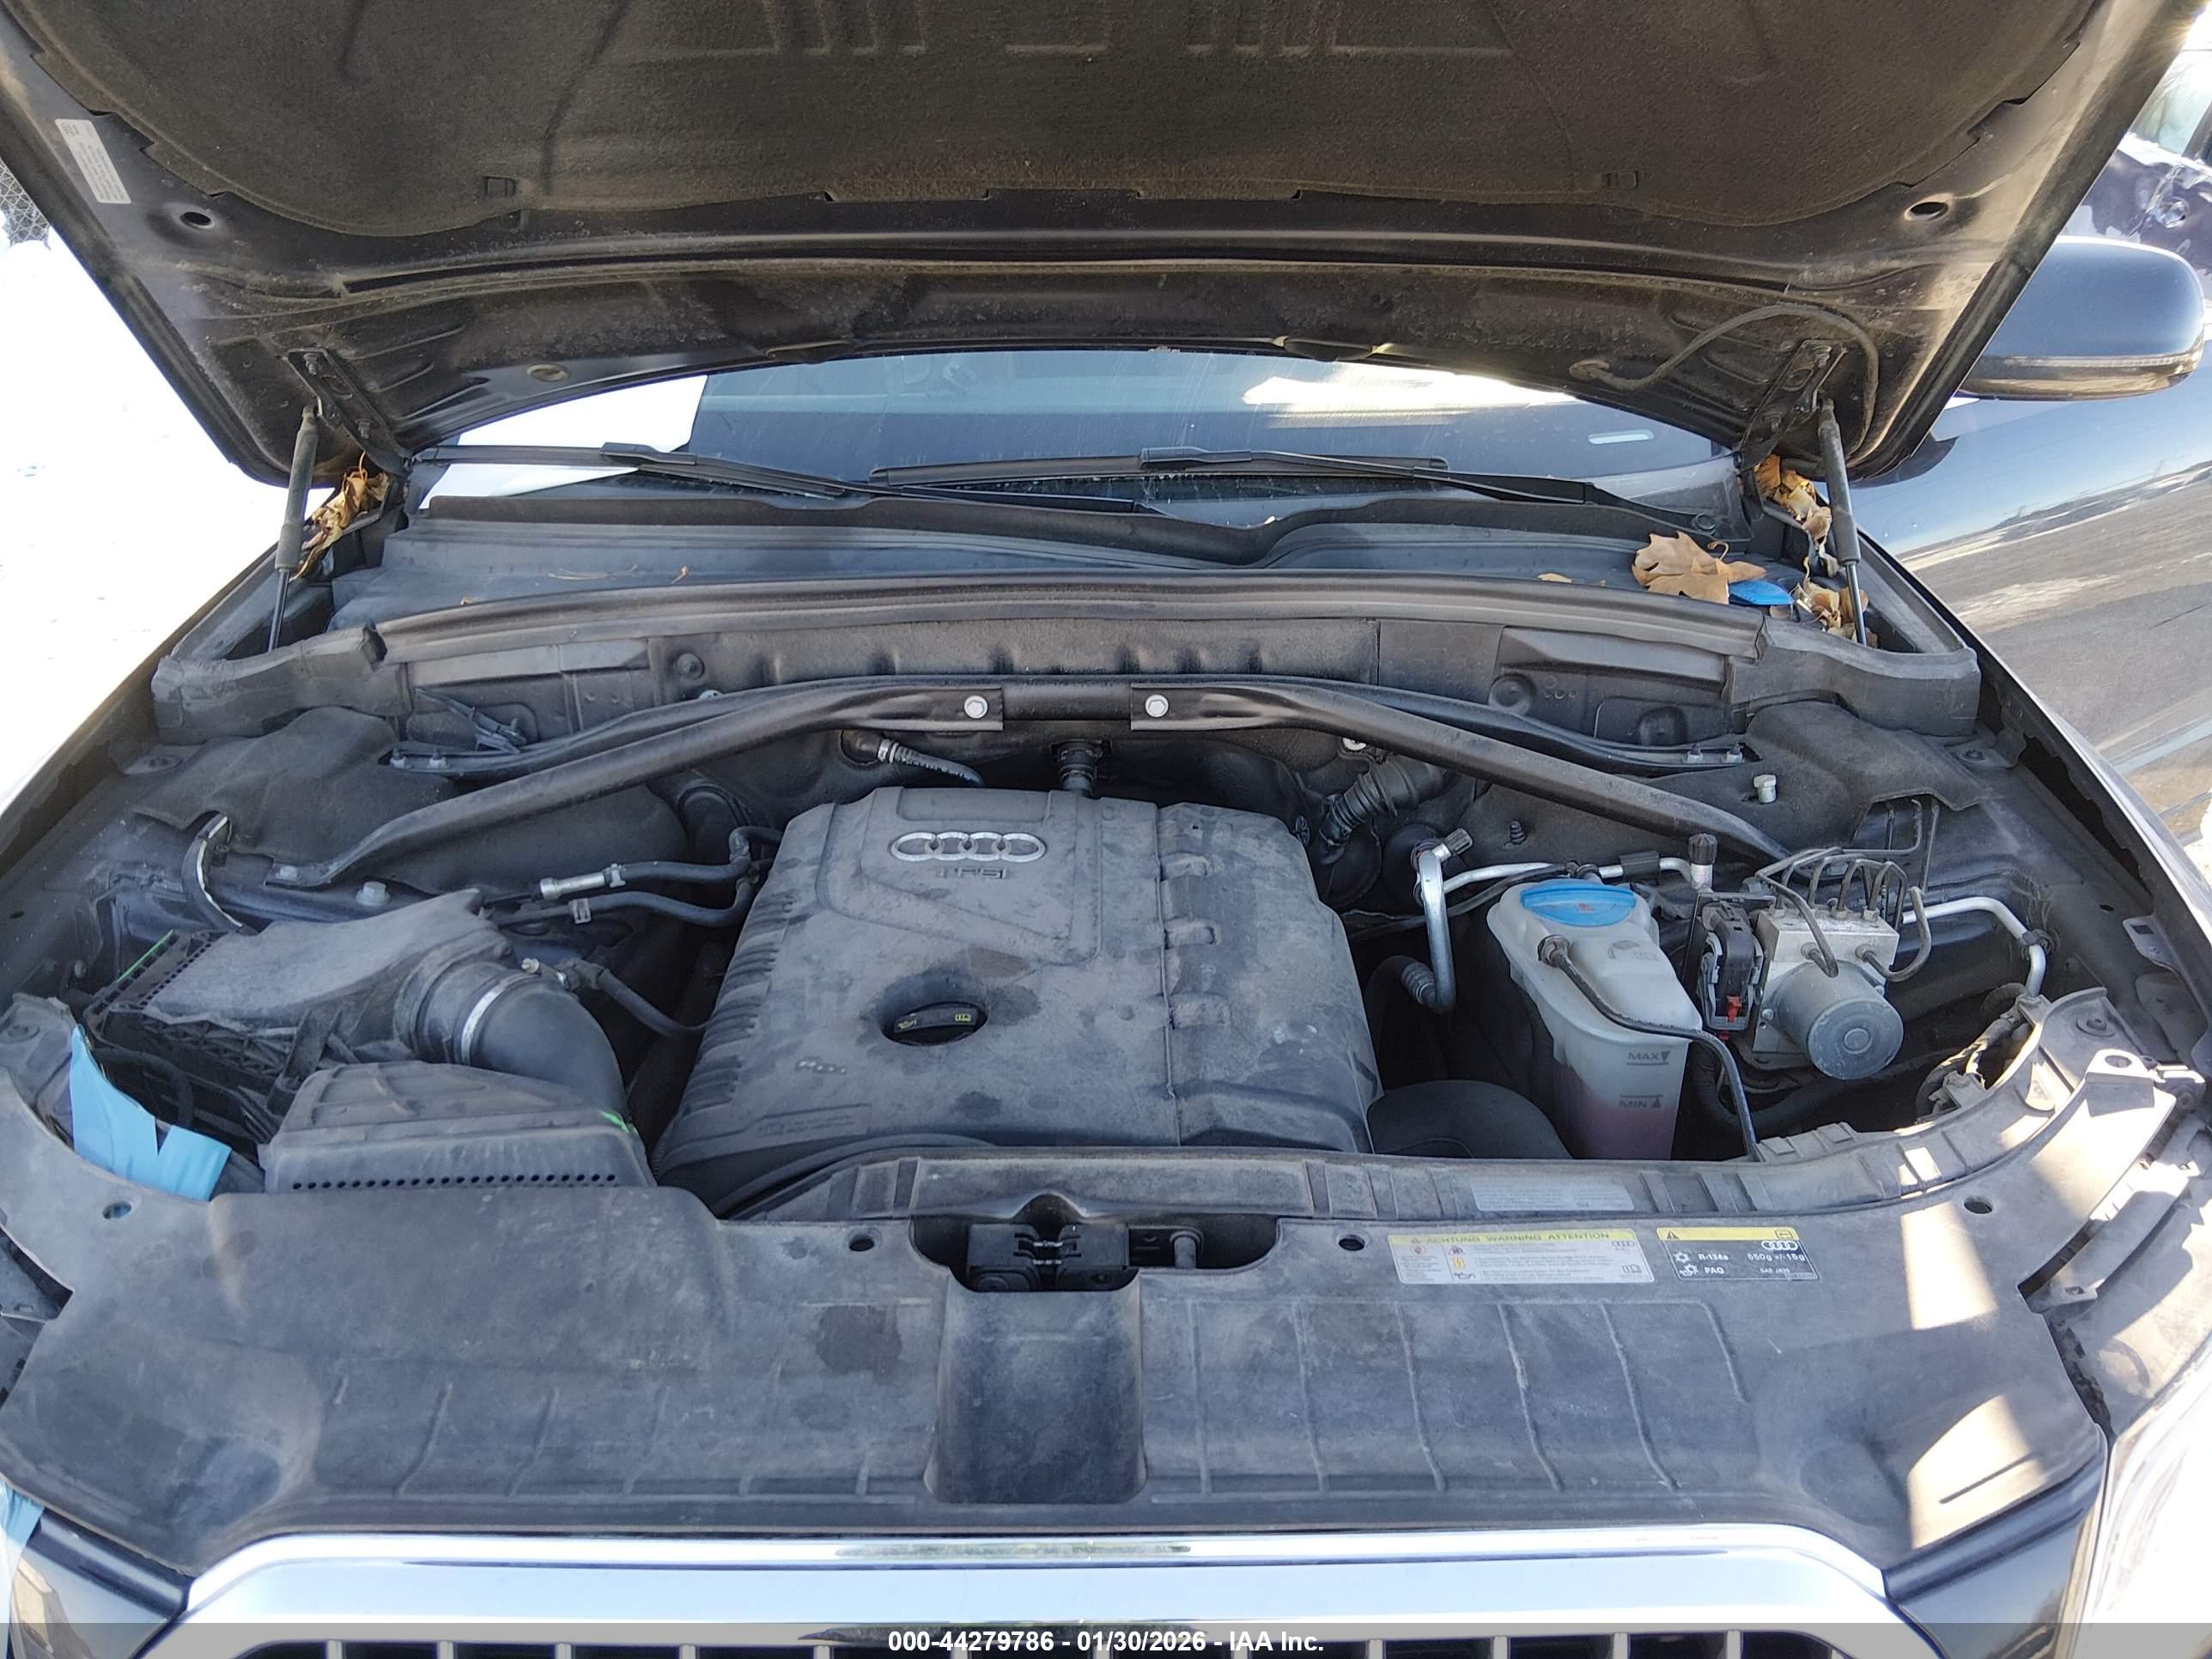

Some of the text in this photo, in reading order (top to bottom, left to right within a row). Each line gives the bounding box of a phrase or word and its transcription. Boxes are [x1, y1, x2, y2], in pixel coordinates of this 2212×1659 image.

[1627, 1052, 1659, 1060] MAX
[1619, 1100, 1648, 1109] MIN
[1548, 1231, 1610, 1240] ATTENTION
